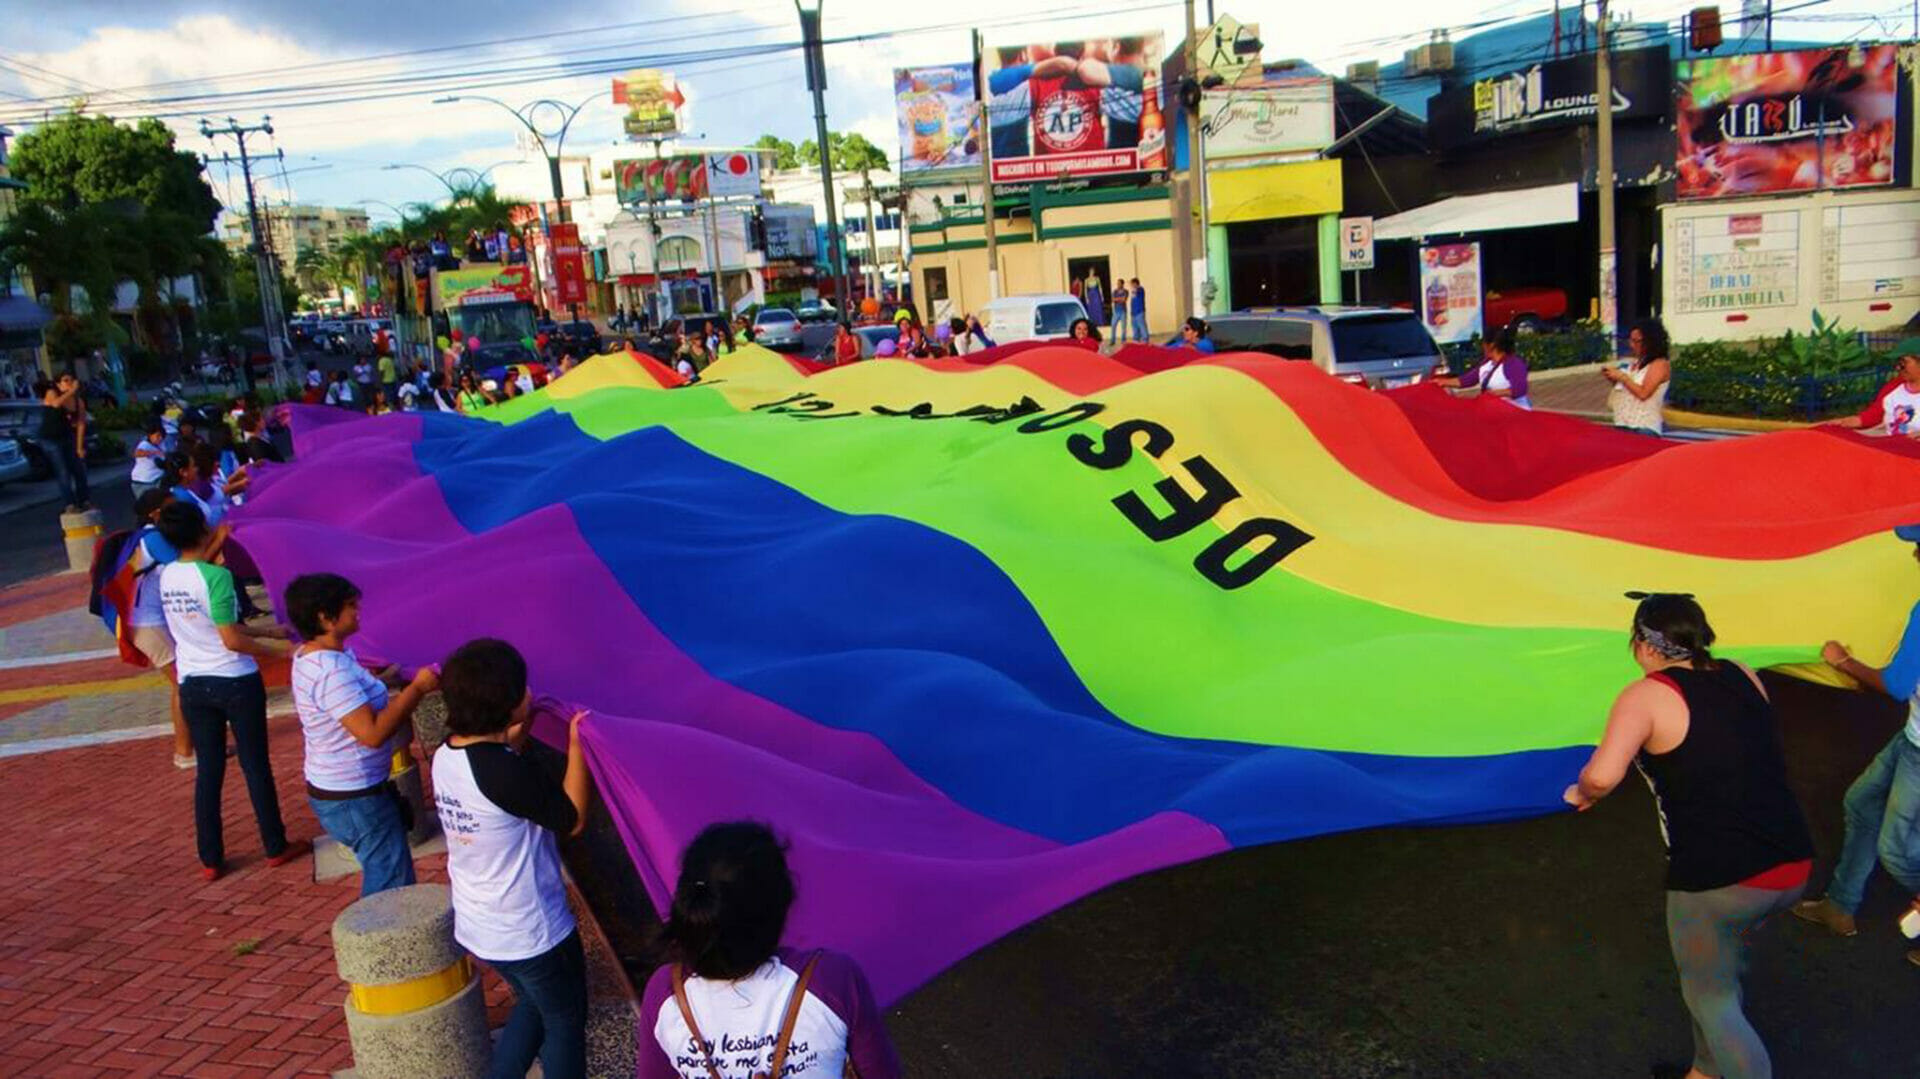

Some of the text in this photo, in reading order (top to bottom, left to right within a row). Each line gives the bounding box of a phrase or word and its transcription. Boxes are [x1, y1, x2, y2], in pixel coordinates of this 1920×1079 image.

[1048, 112, 1083, 132] AP
[1349, 249, 1365, 260] NO
[721, 1032, 782, 1053] lesbian
[735, 1054, 761, 1069] me
